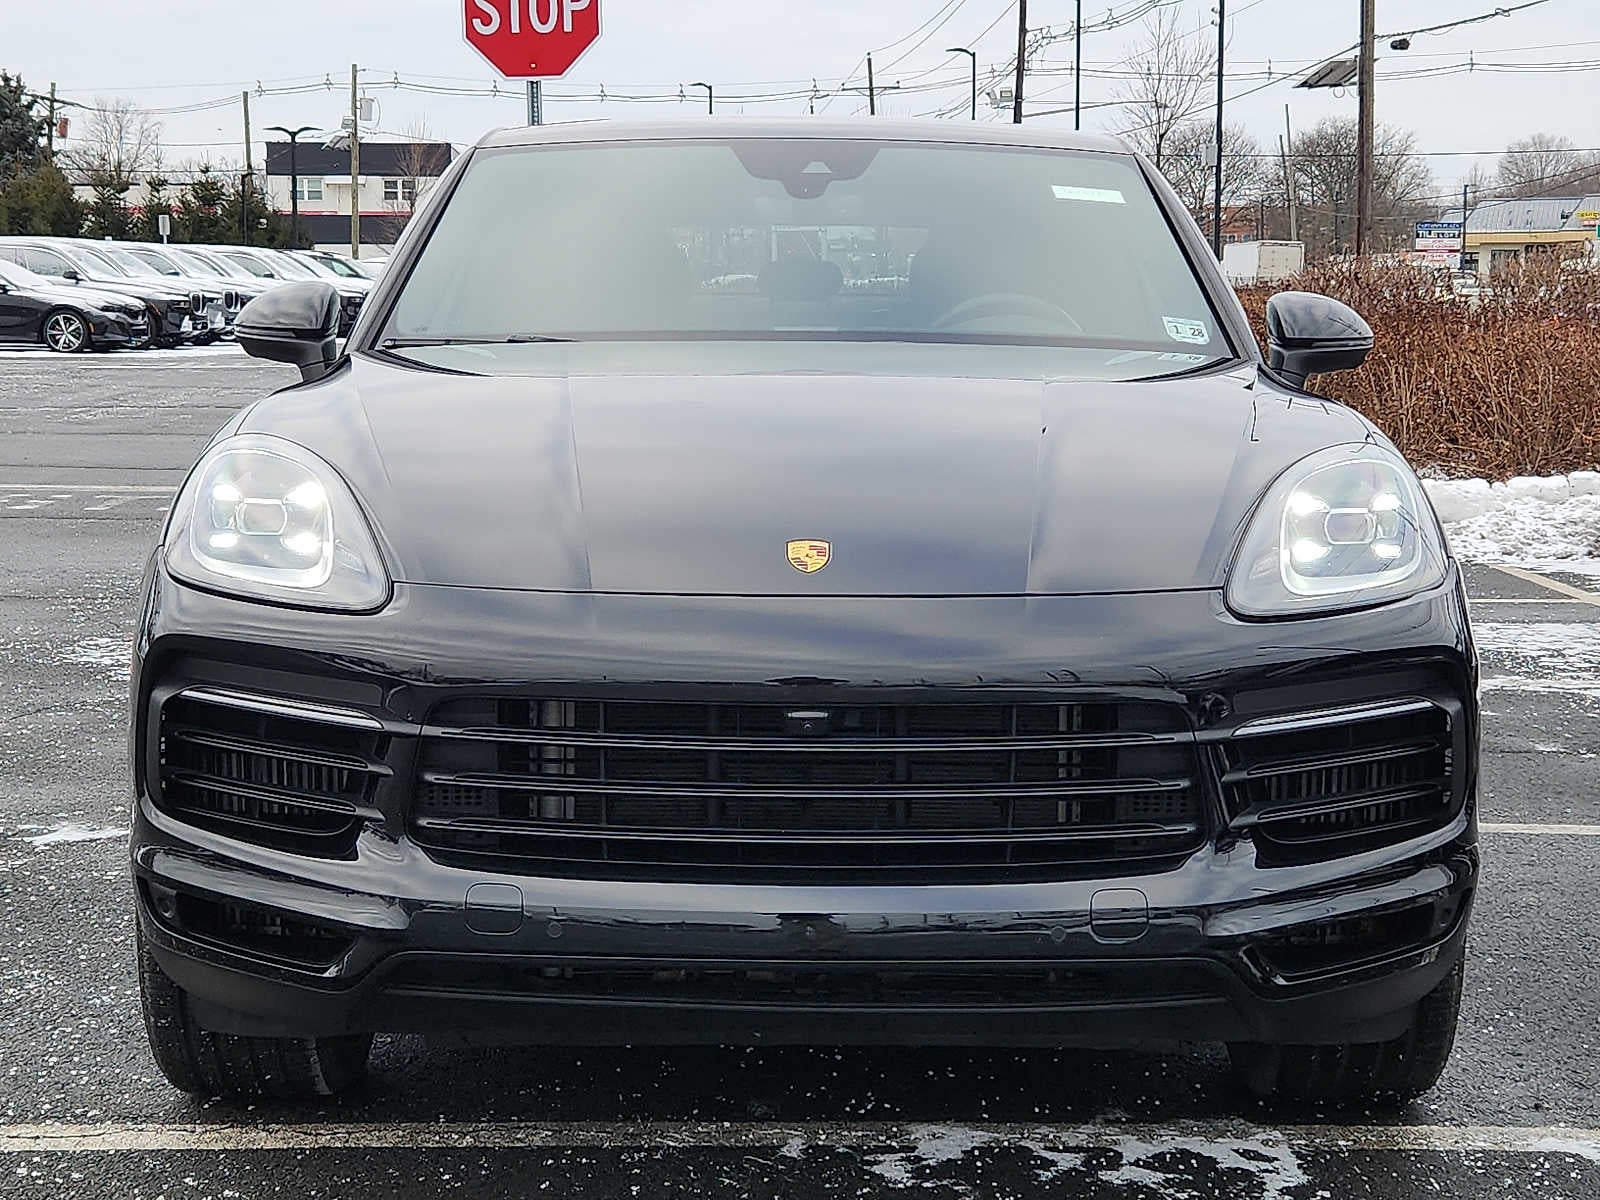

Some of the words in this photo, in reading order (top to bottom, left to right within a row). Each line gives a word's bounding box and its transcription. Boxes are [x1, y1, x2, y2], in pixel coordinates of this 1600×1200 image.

[472, 0, 591, 35] STOP
[1174, 325, 1182, 334] 1
[1189, 327, 1205, 338] 28
